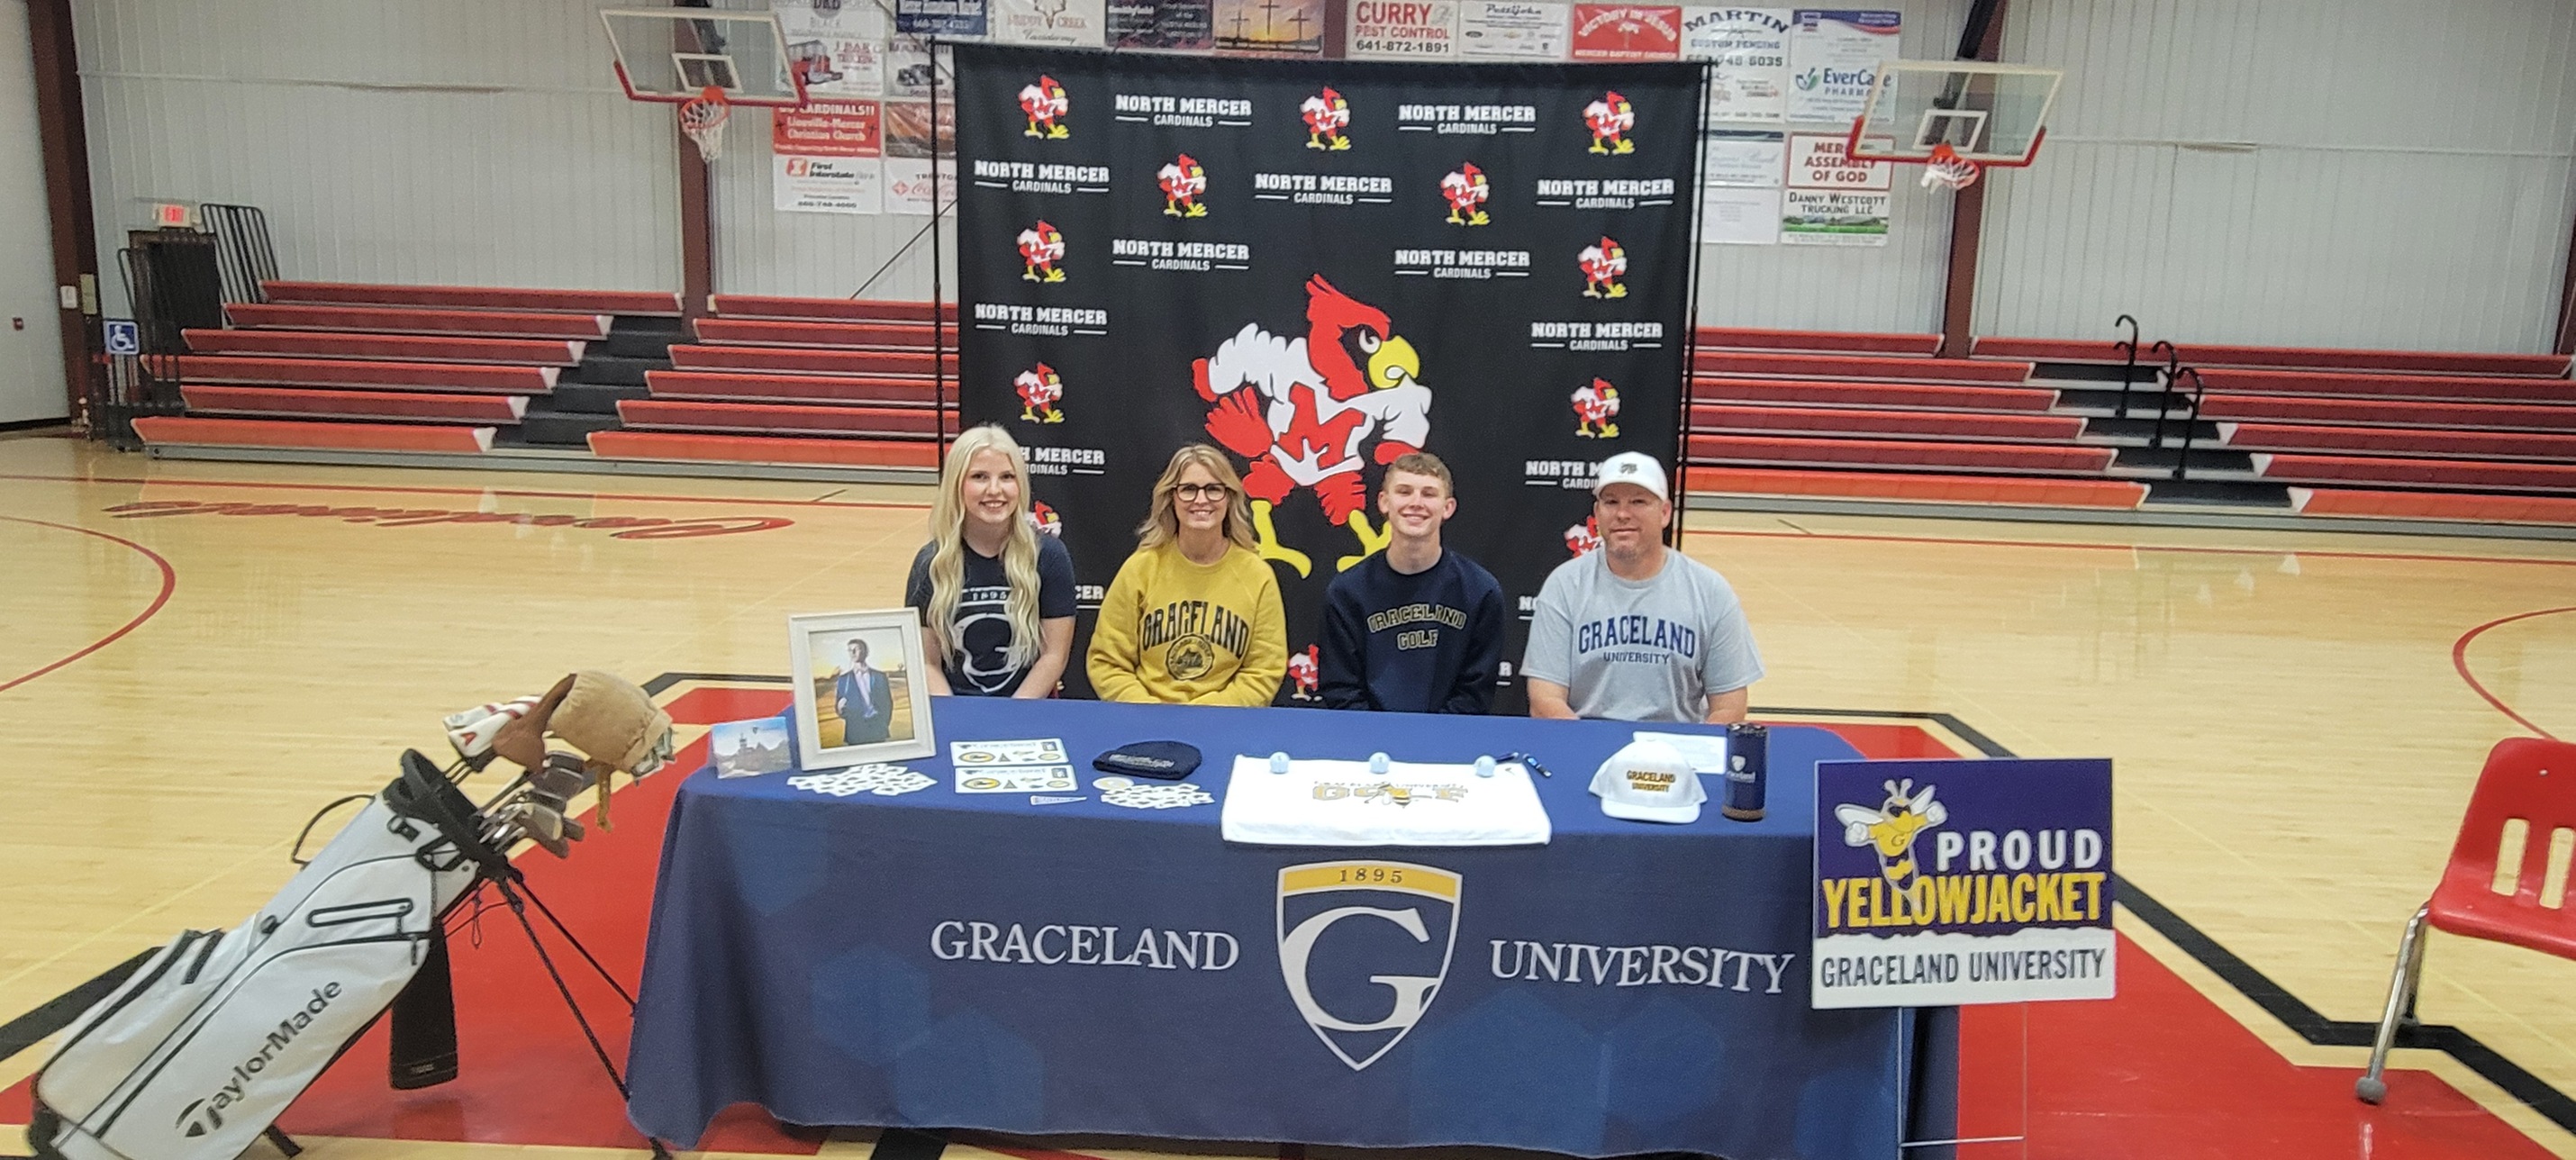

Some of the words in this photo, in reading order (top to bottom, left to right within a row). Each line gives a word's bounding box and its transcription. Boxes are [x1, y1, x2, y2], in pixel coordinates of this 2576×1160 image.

[1356, 2, 1432, 24] CURRY
[1684, 10, 1789, 33] MARTIN
[1356, 25, 1386, 38] PEST
[1391, 27, 1449, 39] CONTROL
[1356, 40, 1449, 52] 641-872-1891
[1823, 68, 1891, 87] EverCae
[1116, 95, 1175, 113] NORTH
[1180, 97, 1251, 116] MERCER
[1399, 105, 1460, 122] NORTH
[1465, 105, 1536, 122] MERCER
[1154, 114, 1213, 128] CARDINALS
[1438, 123, 1497, 134] CARDINALS
[812, 162, 832, 170] First
[975, 160, 1034, 179] NORTH
[1039, 164, 1109, 182] MERCER
[1256, 174, 1316, 190] NORTH
[1320, 176, 1392, 193] MERCER
[1812, 170, 1830, 181] OF
[1836, 171, 1867, 182] GOD
[1012, 180, 1071, 194] CARDINALS
[1537, 179, 1599, 195] NORTH
[1602, 179, 1674, 195] MERCER
[1294, 192, 1353, 204] CARDINALS
[1576, 198, 1635, 209] CARDINALS
[1789, 192, 1825, 204] DANNY
[1829, 193, 1886, 205] WESTCOTT
[1801, 204, 1849, 214] TRUCKING
[1855, 205, 1873, 214] LLC
[1113, 240, 1173, 257] NORTH
[1177, 242, 1249, 260] MERCER
[1152, 258, 1210, 270] CARDINALS
[1395, 250, 1456, 266] NORTH
[1459, 250, 1529, 267] MERCER
[1434, 267, 1492, 278] CARDINALS
[975, 304, 1032, 322] NORTH
[1037, 307, 1107, 325] MERCER
[1011, 323, 1068, 336] CARDINALS
[1532, 322, 1591, 338] NORTH
[1595, 322, 1663, 338] MERCER
[1570, 340, 1628, 350] CARDINALS
[1035, 447, 1105, 465] MERCER
[1026, 464, 1068, 476] DINALS
[1526, 461, 1584, 476] NORTH
[1563, 478, 1598, 489] CARDI
[1397, 629, 1439, 650] GOLF
[1578, 615, 1695, 658] GRACELAND
[1603, 651, 1670, 664] UNIVERSITY
[1627, 770, 1676, 783] GRACELAND
[1937, 829, 2103, 872] PROUD
[1338, 867, 1403, 884] 1895
[1822, 872, 2106, 929] YELLOWJACKET
[930, 920, 1239, 971] GRACELAND
[1489, 939, 1795, 993] UNIVERSITY
[1821, 952, 1959, 987] GRACELAND
[1969, 947, 2107, 983] UNIVERSITY
[176, 981, 343, 1138] TaylorMade
